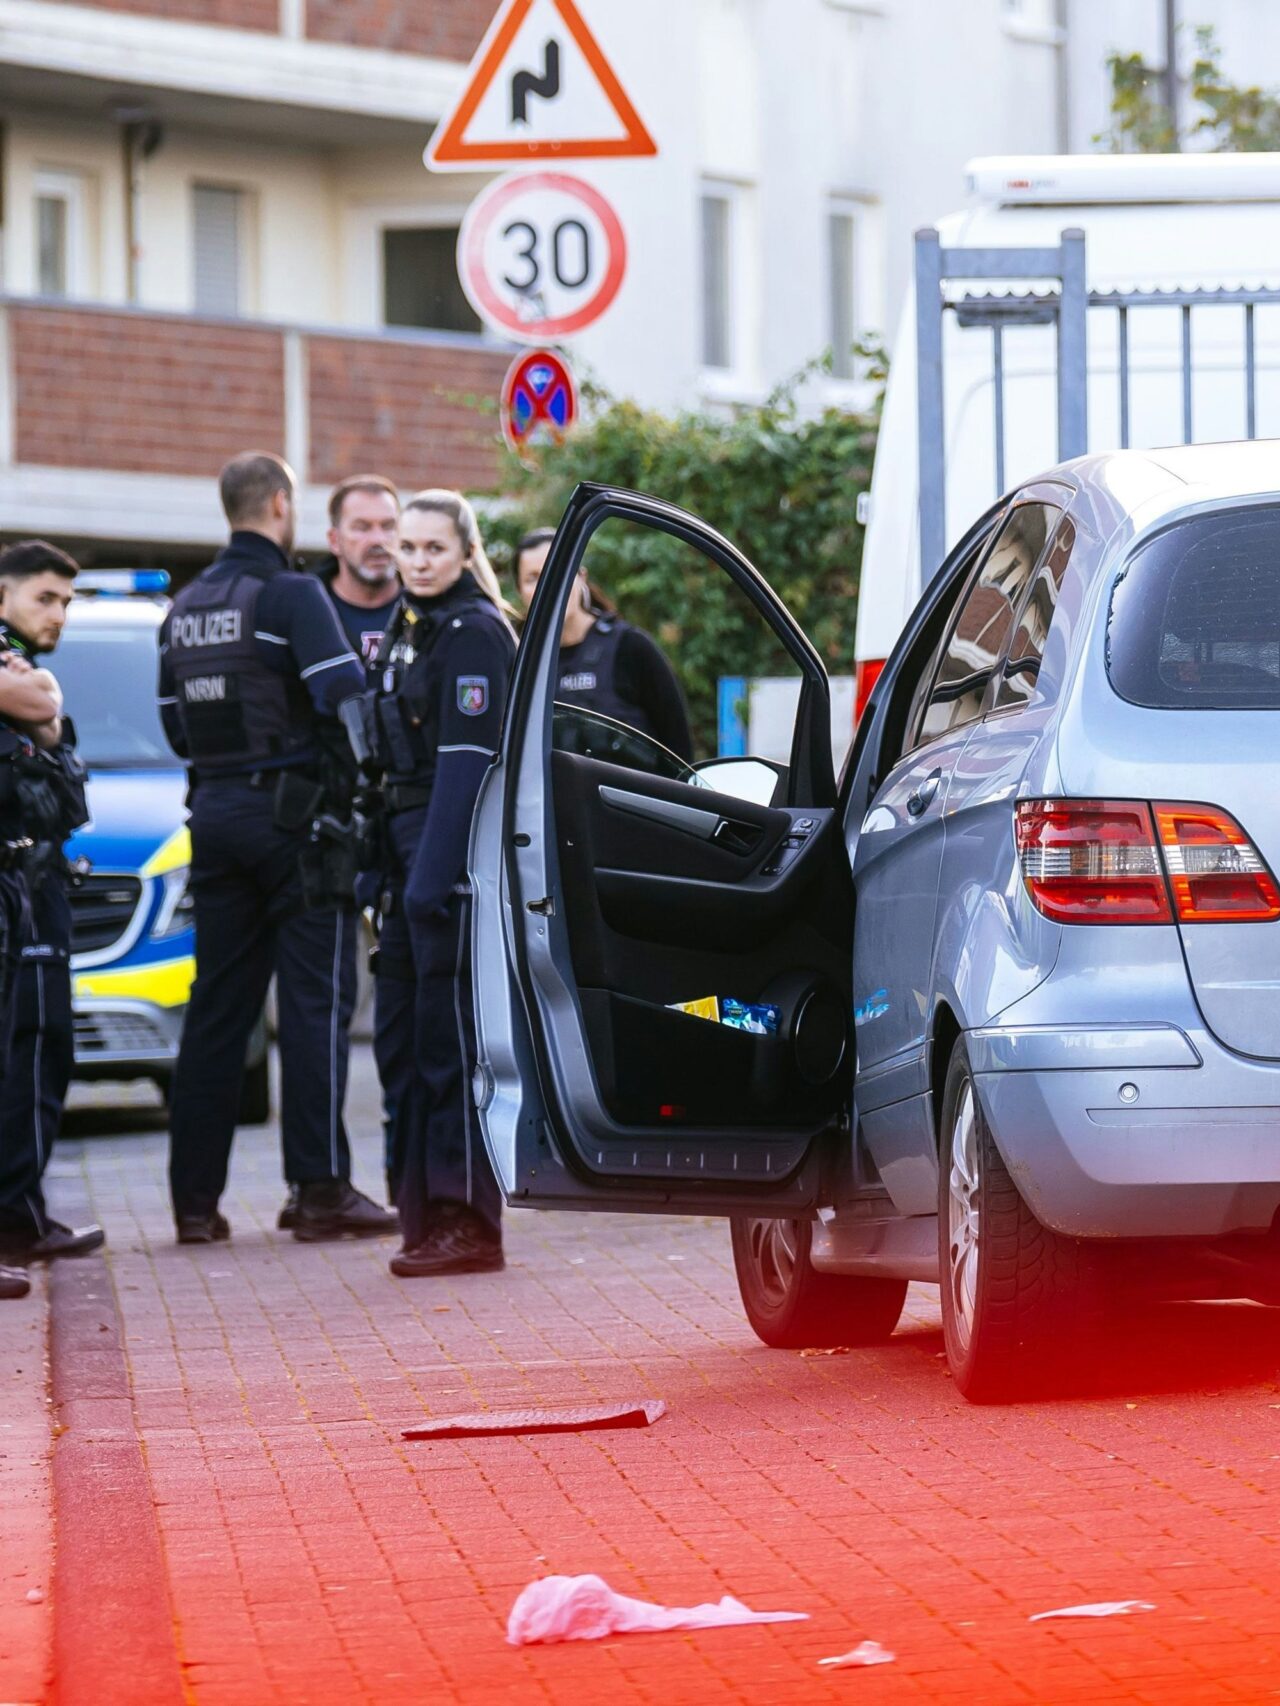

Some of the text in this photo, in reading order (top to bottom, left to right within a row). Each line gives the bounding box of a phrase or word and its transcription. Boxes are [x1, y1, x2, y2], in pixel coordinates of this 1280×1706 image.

[503, 220, 589, 288] 30
[171, 609, 242, 648] POLIZEI
[184, 675, 226, 703] NRW
